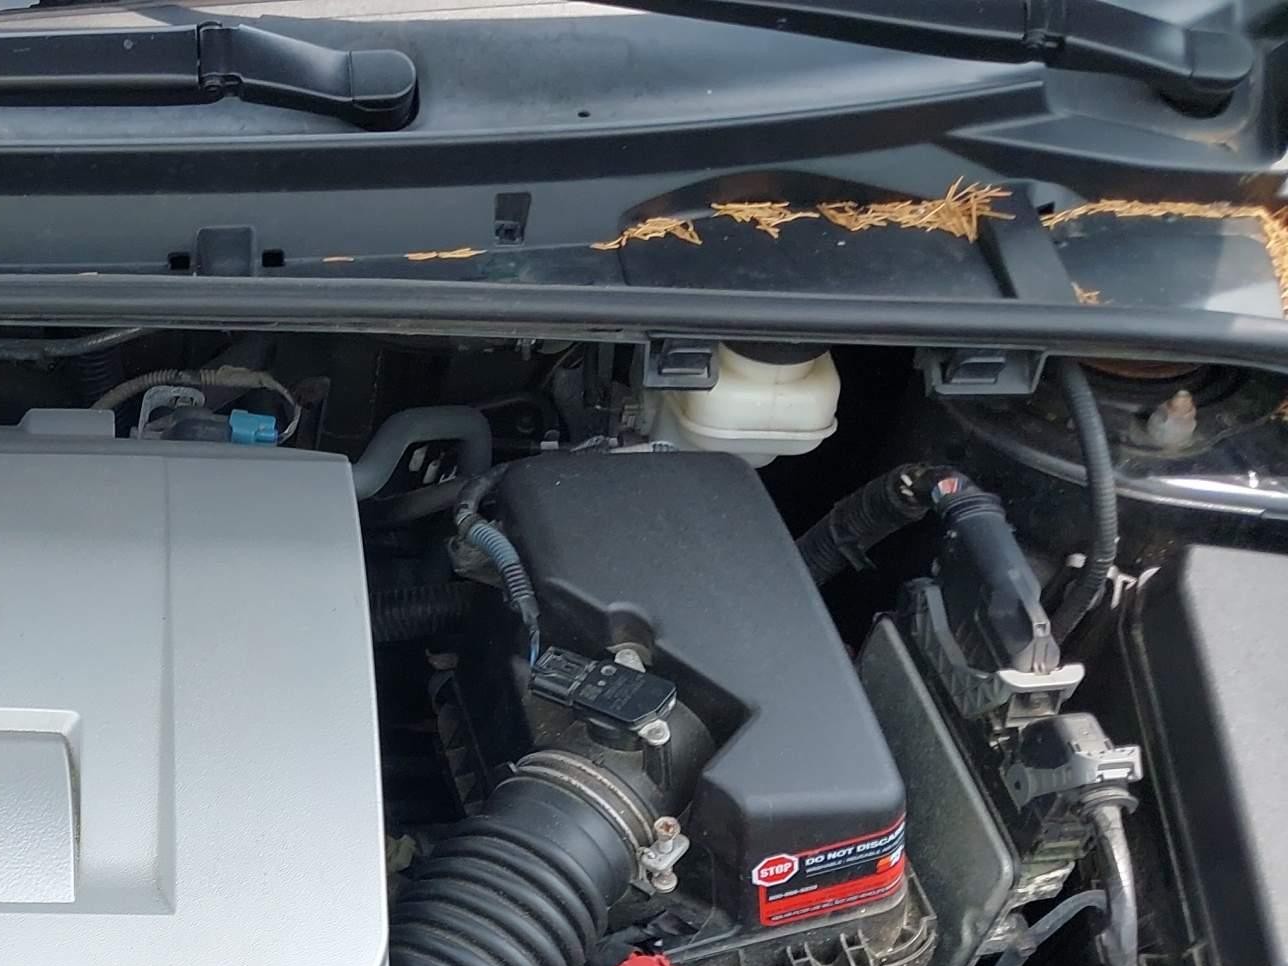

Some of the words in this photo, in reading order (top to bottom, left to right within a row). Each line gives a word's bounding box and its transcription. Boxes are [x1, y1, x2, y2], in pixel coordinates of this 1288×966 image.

[805, 854, 824, 866] DO
[827, 847, 854, 861] NOT
[759, 862, 793, 879] STOP
